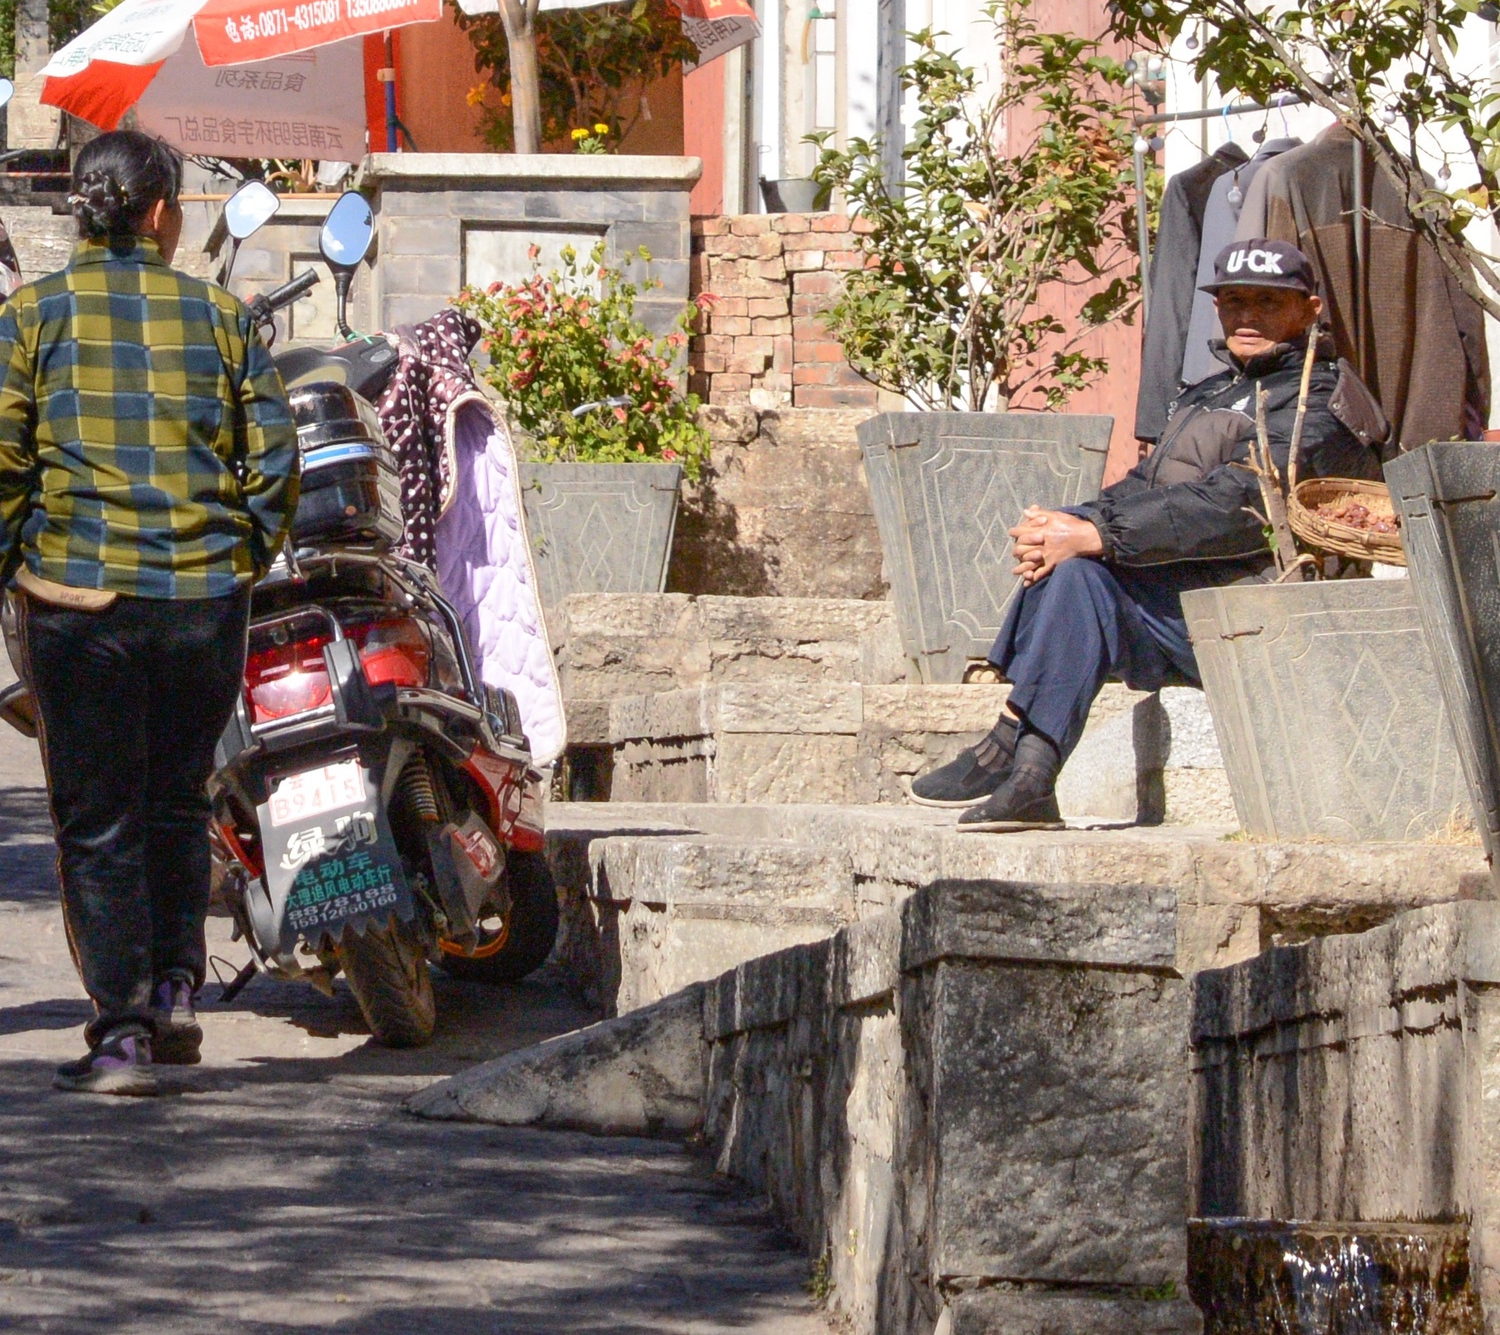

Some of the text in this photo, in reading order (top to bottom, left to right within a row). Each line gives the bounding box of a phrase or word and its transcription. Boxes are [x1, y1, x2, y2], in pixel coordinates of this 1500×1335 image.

[60, 591, 85, 603] SPORT
[296, 851, 372, 886] 电动车
